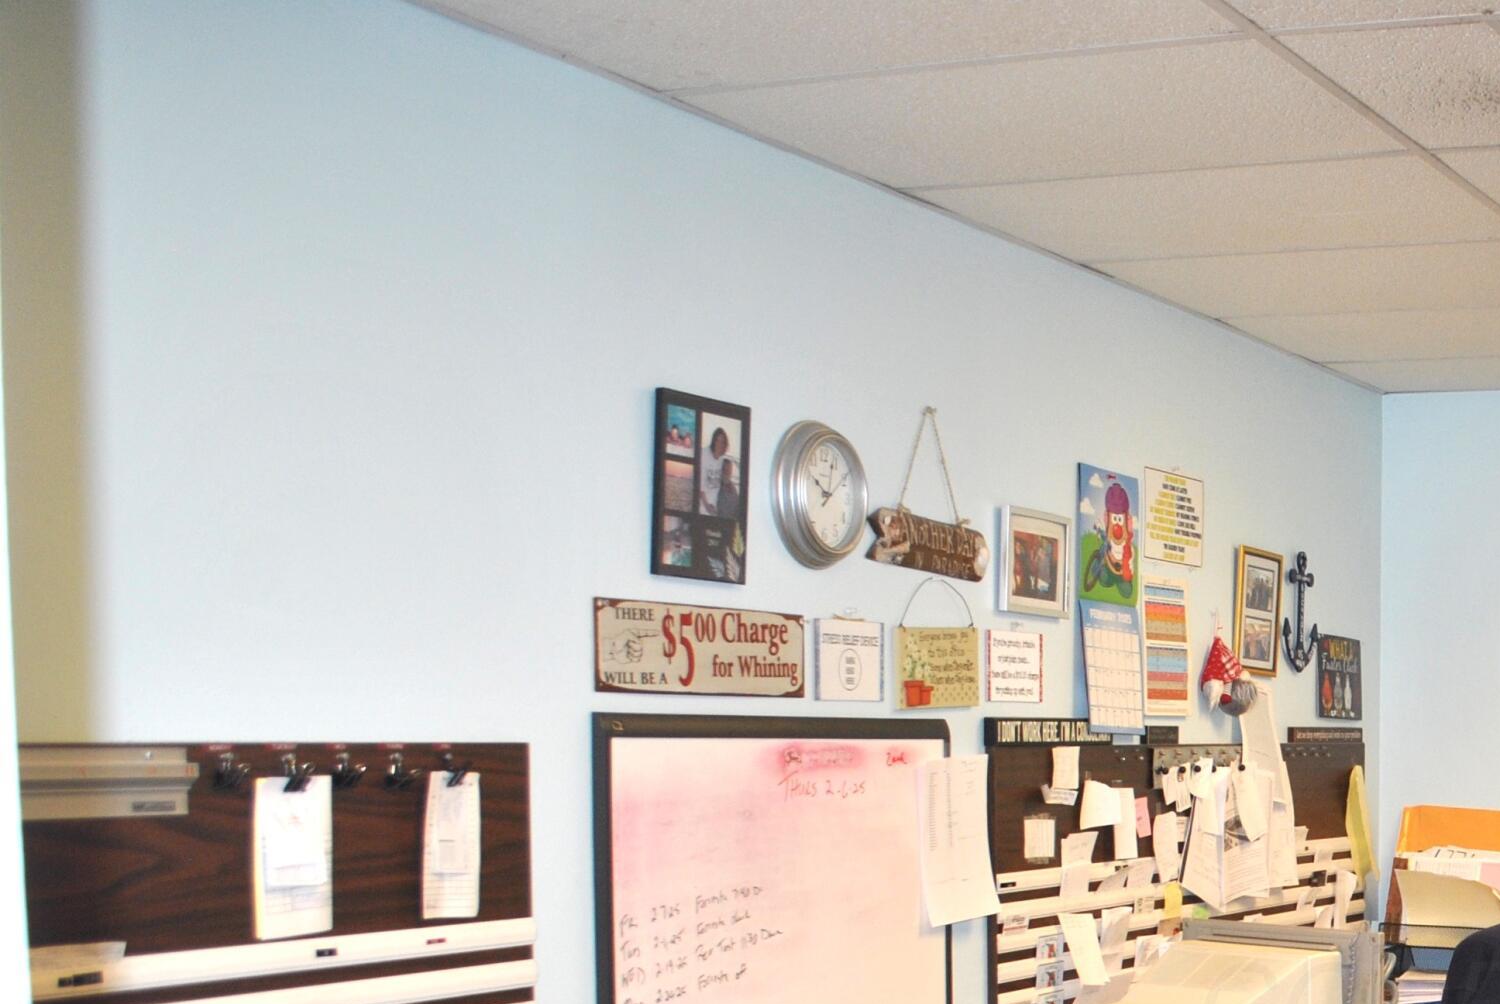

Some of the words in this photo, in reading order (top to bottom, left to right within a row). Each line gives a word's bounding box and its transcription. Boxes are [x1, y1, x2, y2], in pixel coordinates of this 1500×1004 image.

[614, 607, 654, 621] THERE
[721, 612, 789, 656] Charge
[604, 671, 636, 685] WILL
[641, 672, 656, 685] BE
[659, 672, 668, 685] A
[712, 654, 734, 678] for
[738, 655, 798, 687] Whining
[1002, 720, 1021, 742] DON'T
[1022, 720, 1042, 742] WORK
